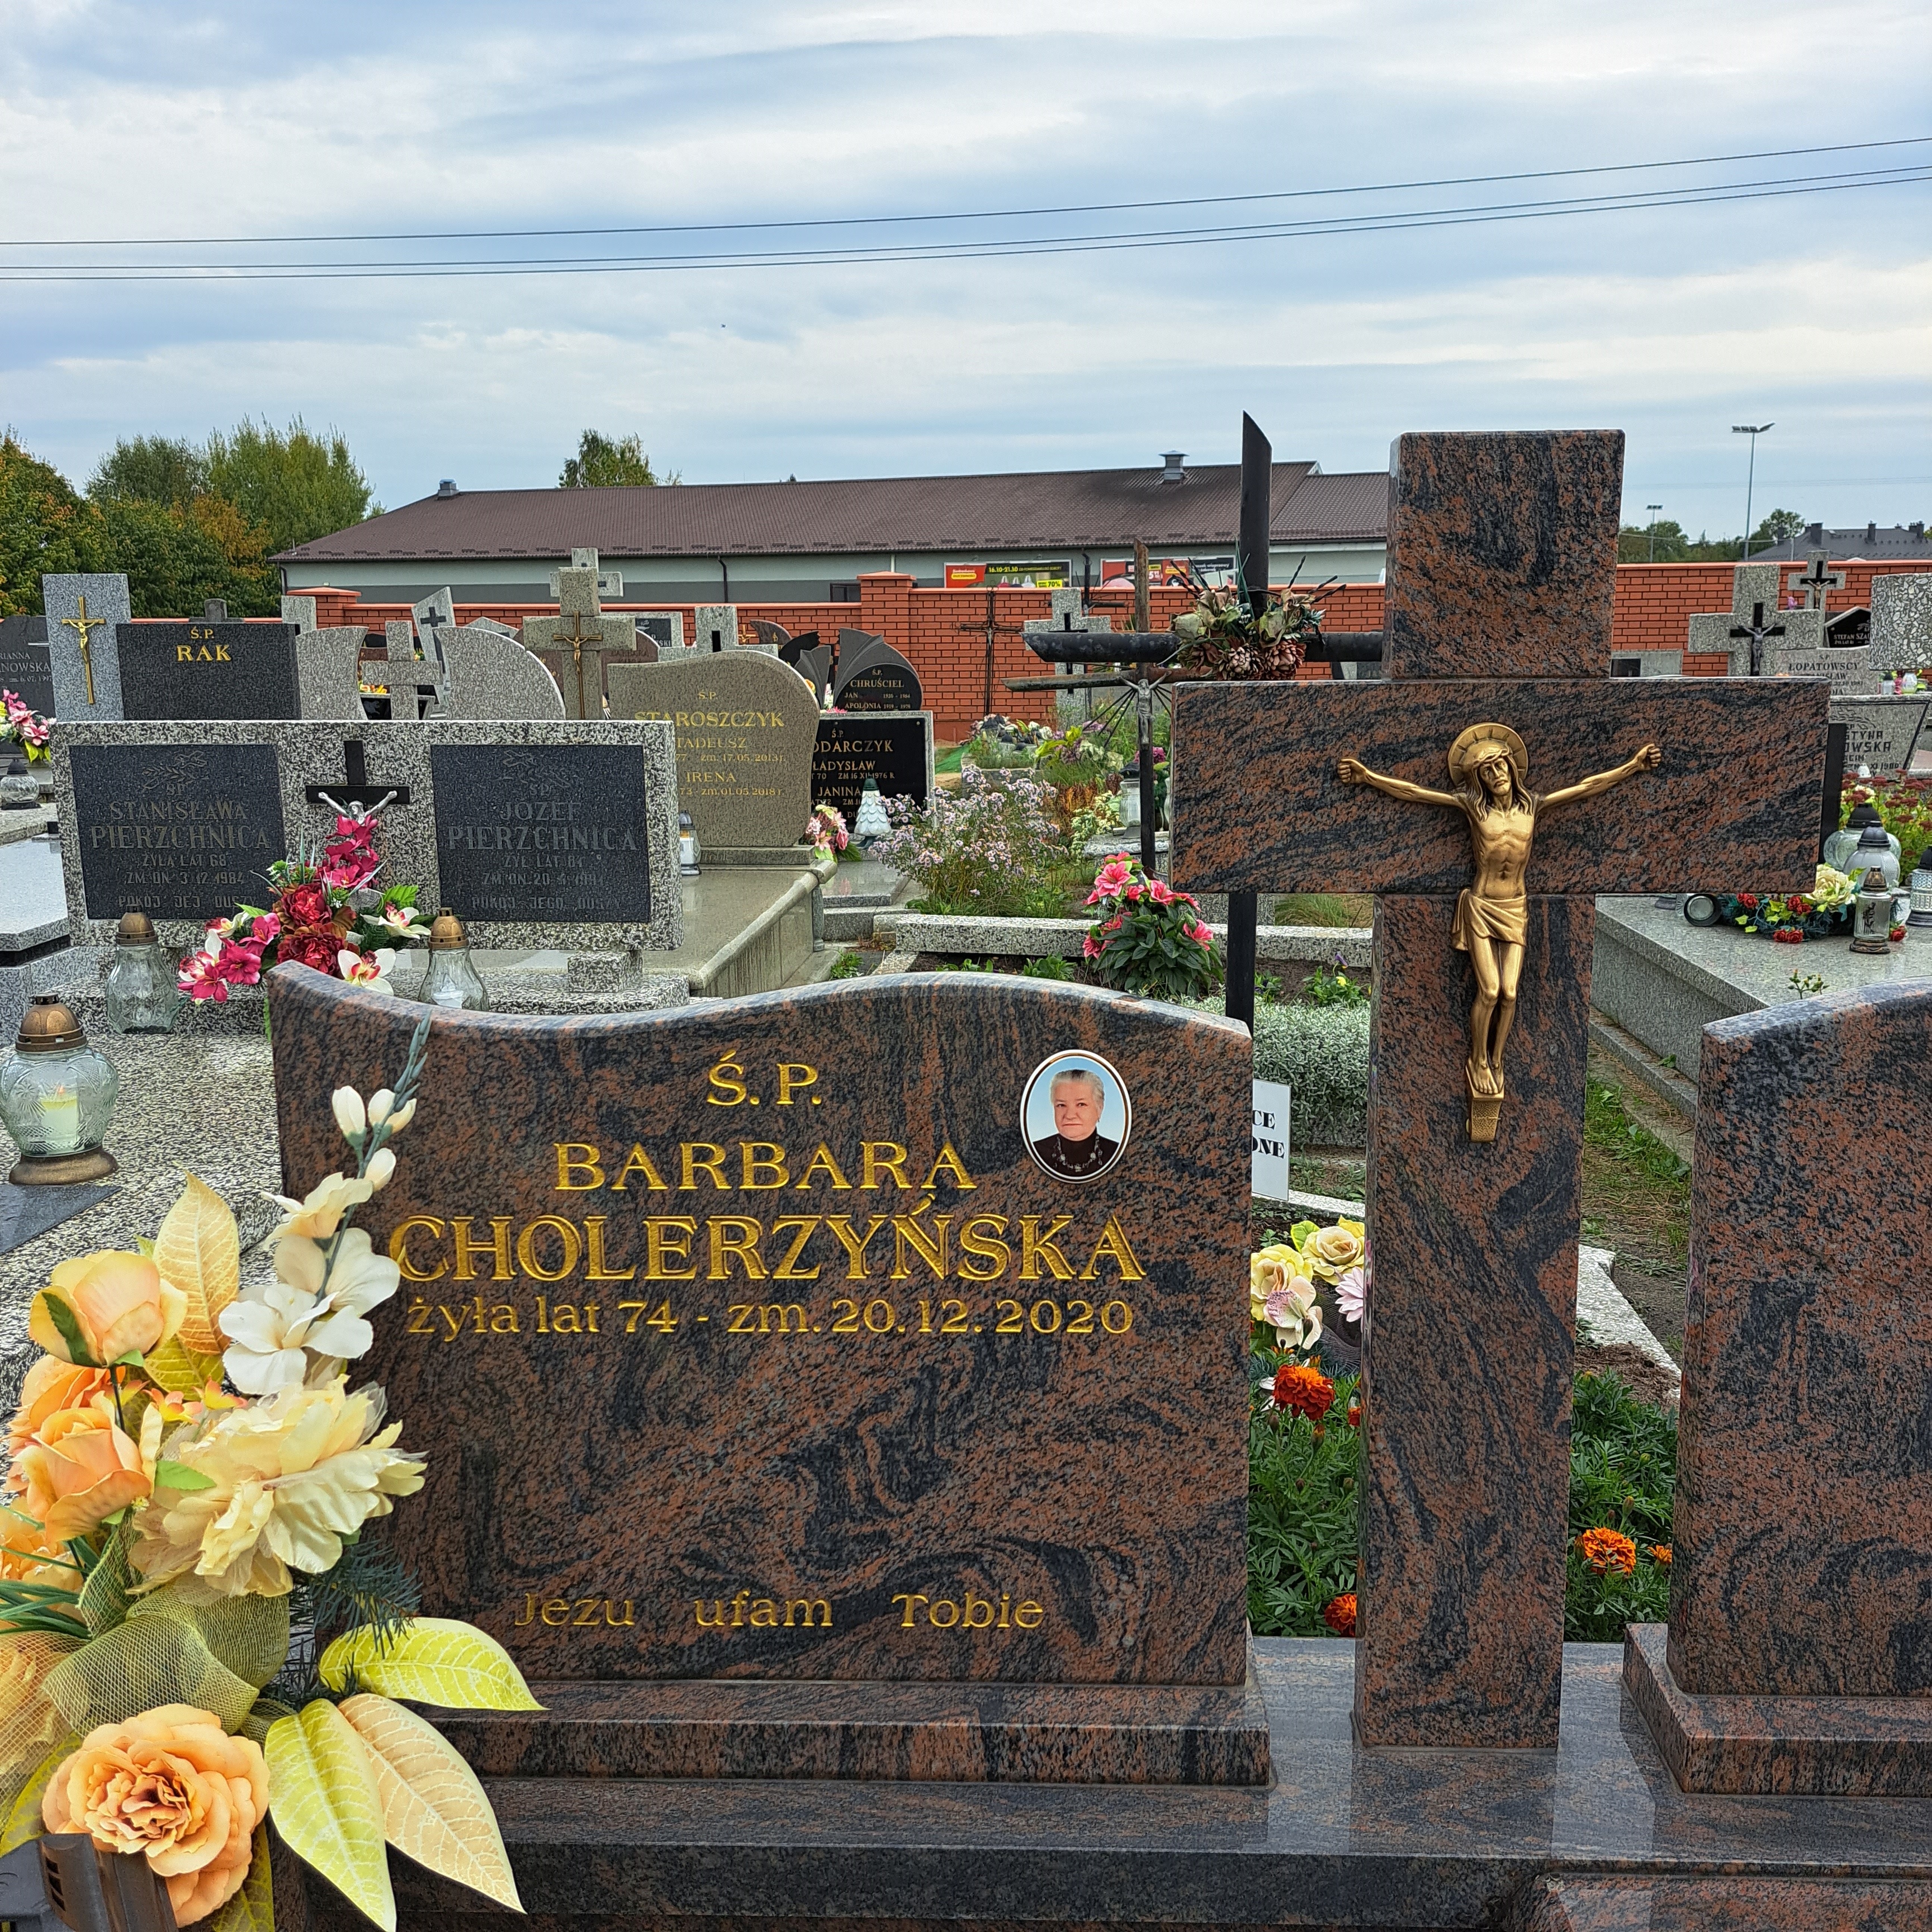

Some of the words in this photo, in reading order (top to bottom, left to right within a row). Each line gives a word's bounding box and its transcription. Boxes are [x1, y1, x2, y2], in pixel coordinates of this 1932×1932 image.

[177, 644, 231, 661] RAK
[0, 662, 51, 673] NOWSKA
[850, 677, 905, 688] CHRUŚCIEL
[676, 737, 747, 749] TADEUSZ
[686, 771, 737, 783] IRENA
[817, 786, 861, 797] JANINA
[110, 799, 248, 820] STANISŁAWA
[91, 825, 271, 849] PIERZCHNICA
[448, 826, 638, 850] PIERZCHNICA
[210, 854, 226, 866] 68
[174, 896, 201, 908] JEJ
[552, 1142, 978, 1191] BARBARA
[389, 1193, 1147, 1282] CHOLERZYŃSKA
[407, 1296, 521, 1342] żyła
[536, 1296, 601, 1334] lat
[617, 1300, 678, 1334] 74
[514, 1592, 636, 1627] Jezu
[694, 1589, 834, 1627] ufam
[891, 1592, 1045, 1629] Tobie
